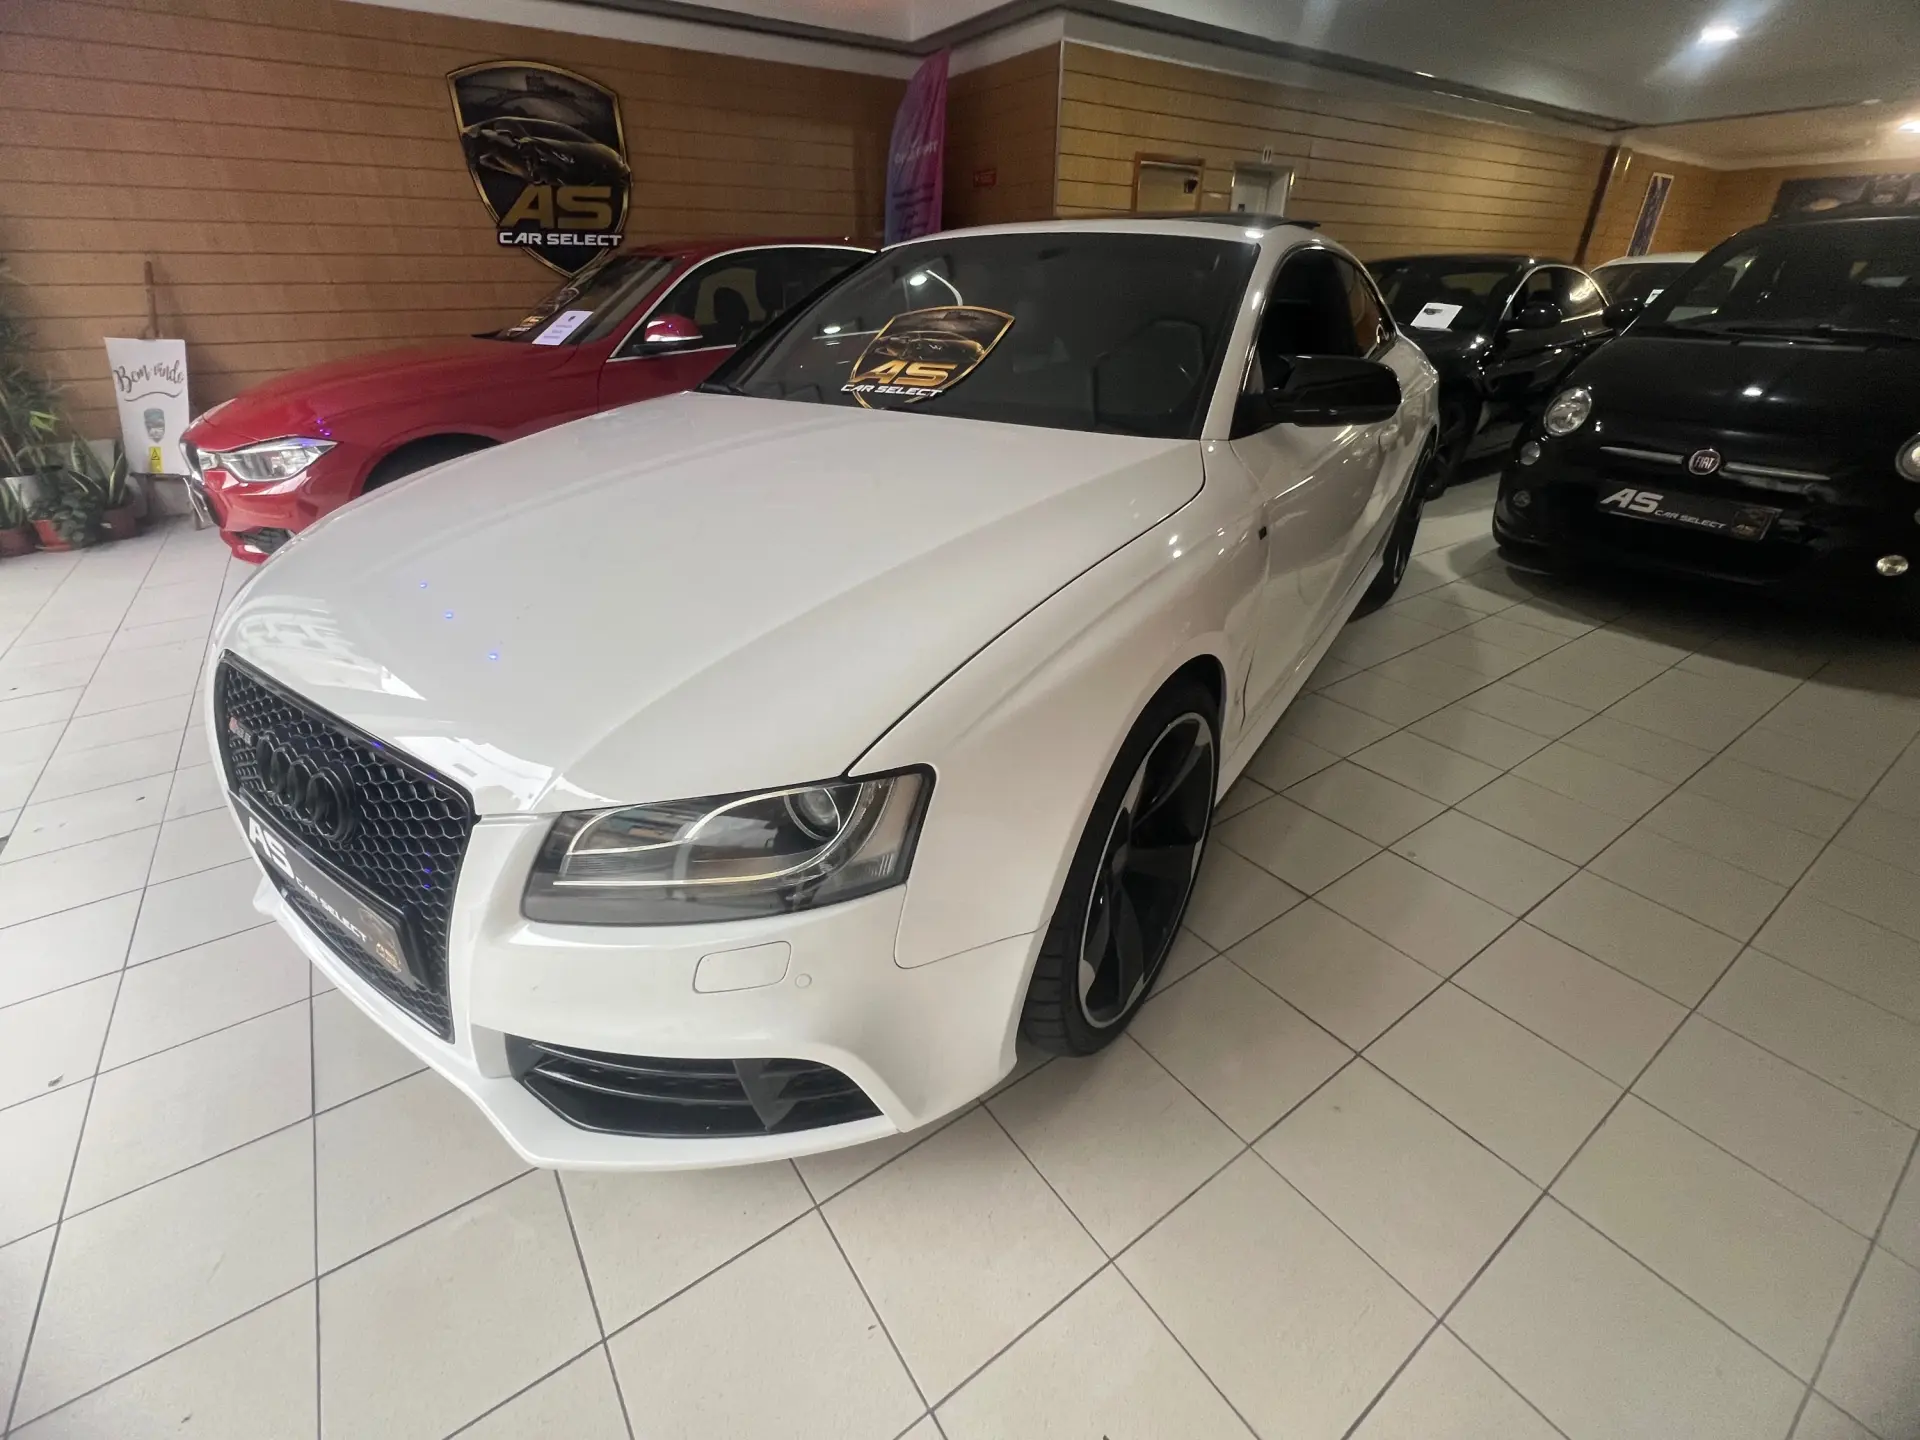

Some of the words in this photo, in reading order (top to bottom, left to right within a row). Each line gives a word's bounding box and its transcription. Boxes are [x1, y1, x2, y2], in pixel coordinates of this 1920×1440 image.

[500, 184, 612, 229] AS
[499, 231, 542, 245] CAR
[547, 233, 622, 246] SELECT
[853, 360, 958, 386] AS
[841, 384, 874, 392] CAR
[875, 385, 943, 397] SELECT
[1694, 456, 1714, 469] FIAT
[1600, 488, 1664, 513] AS
[1655, 510, 1679, 521] CAR
[1680, 514, 1727, 529] SELECT
[250, 816, 295, 879] AS
[320, 896, 367, 942] SELECT
